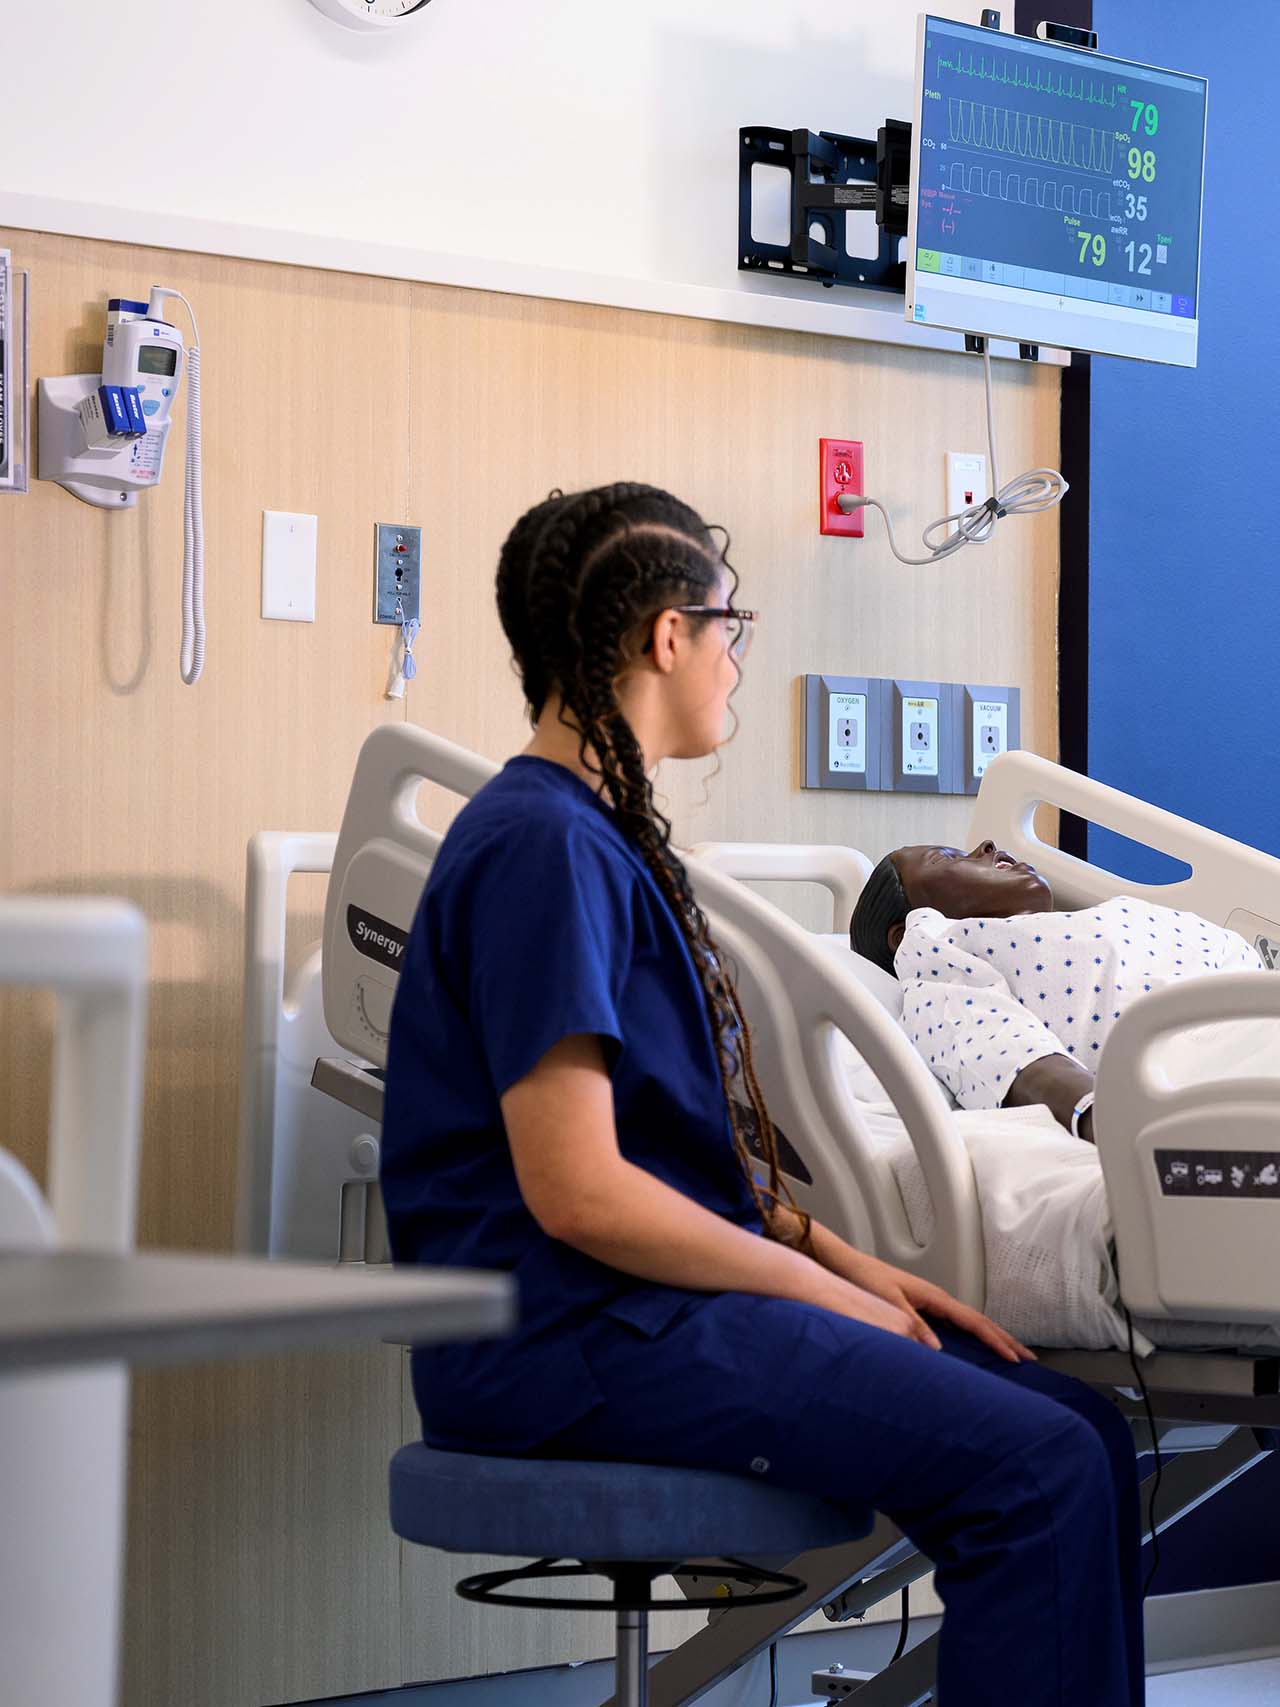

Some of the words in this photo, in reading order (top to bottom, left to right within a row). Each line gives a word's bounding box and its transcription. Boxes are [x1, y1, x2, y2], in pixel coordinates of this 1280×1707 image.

[924, 89, 941, 100] Pleth
[1130, 100, 1159, 136] 79
[1127, 147, 1156, 183] 98
[1124, 193, 1148, 222] 35
[1077, 231, 1106, 266] 79
[1124, 240, 1153, 276] 12
[112, 393, 123, 419] Baxter
[129, 394, 140, 420] Baxter
[836, 696, 860, 705] OXYGEN
[980, 704, 1002, 712] VACUUM
